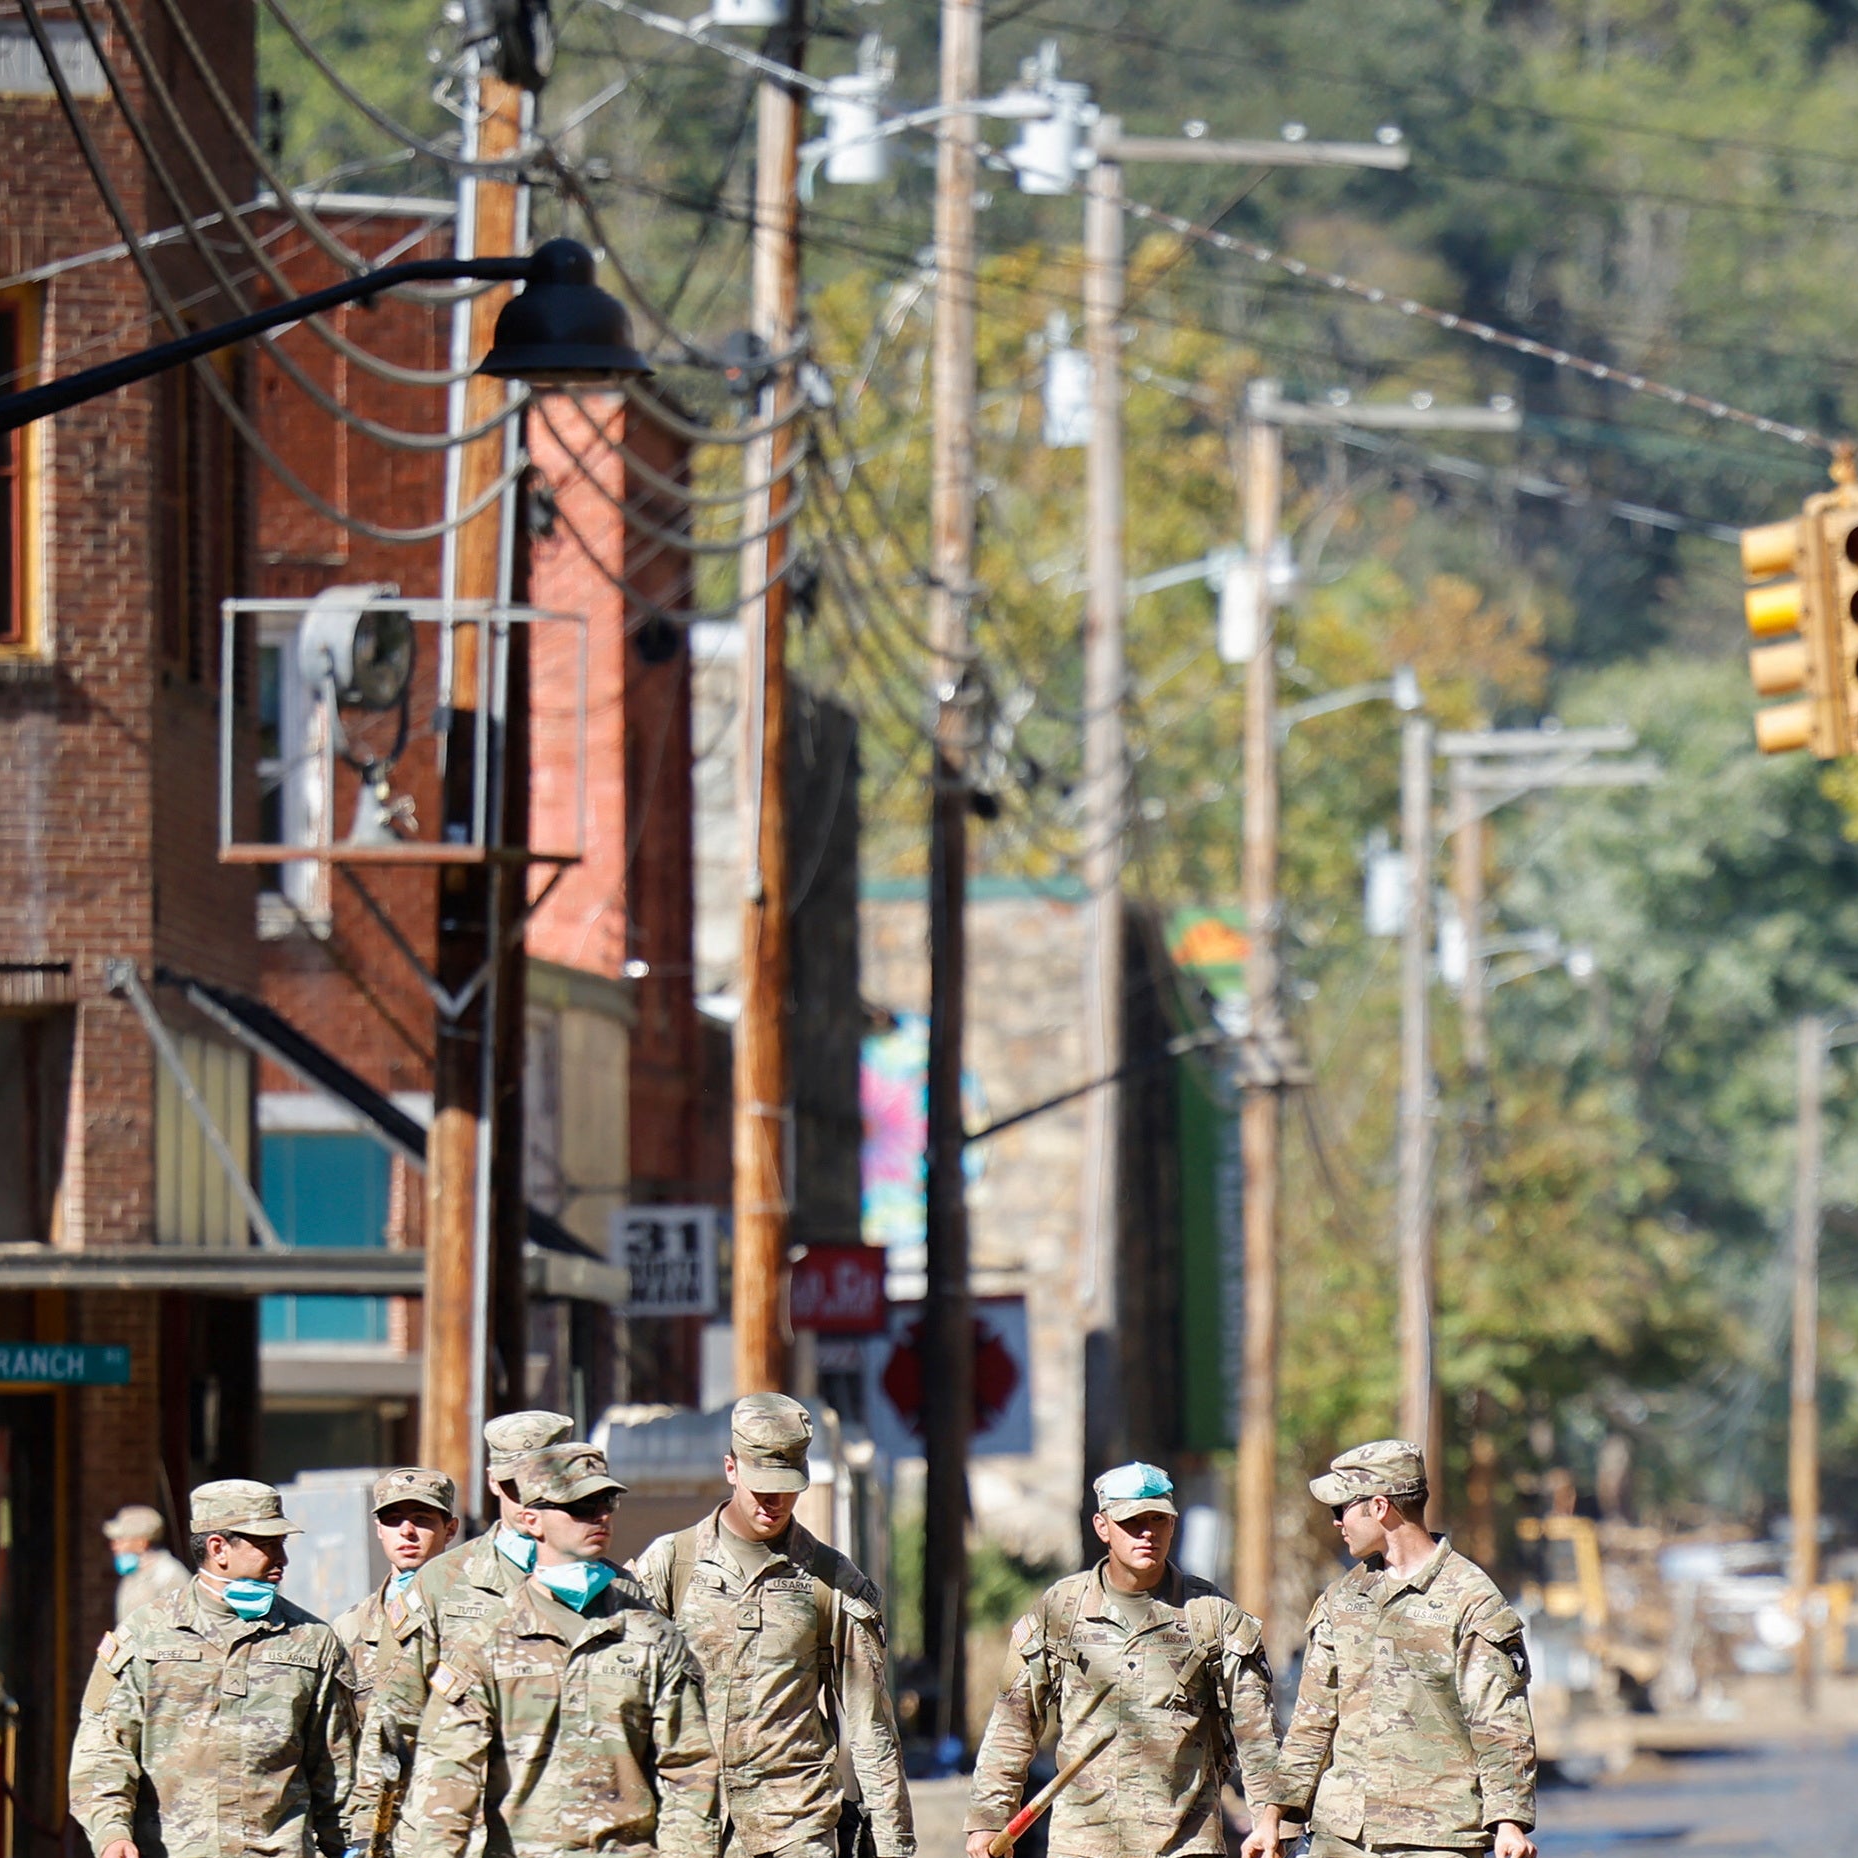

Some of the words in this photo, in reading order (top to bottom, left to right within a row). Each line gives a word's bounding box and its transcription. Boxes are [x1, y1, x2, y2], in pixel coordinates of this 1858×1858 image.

[789, 1581, 813, 1591] ARMY
[1345, 1602, 1369, 1612] CURIEL
[1428, 1612, 1451, 1623] ARMY
[157, 1650, 184, 1659] PEREZ
[287, 1654, 313, 1666] ARMY
